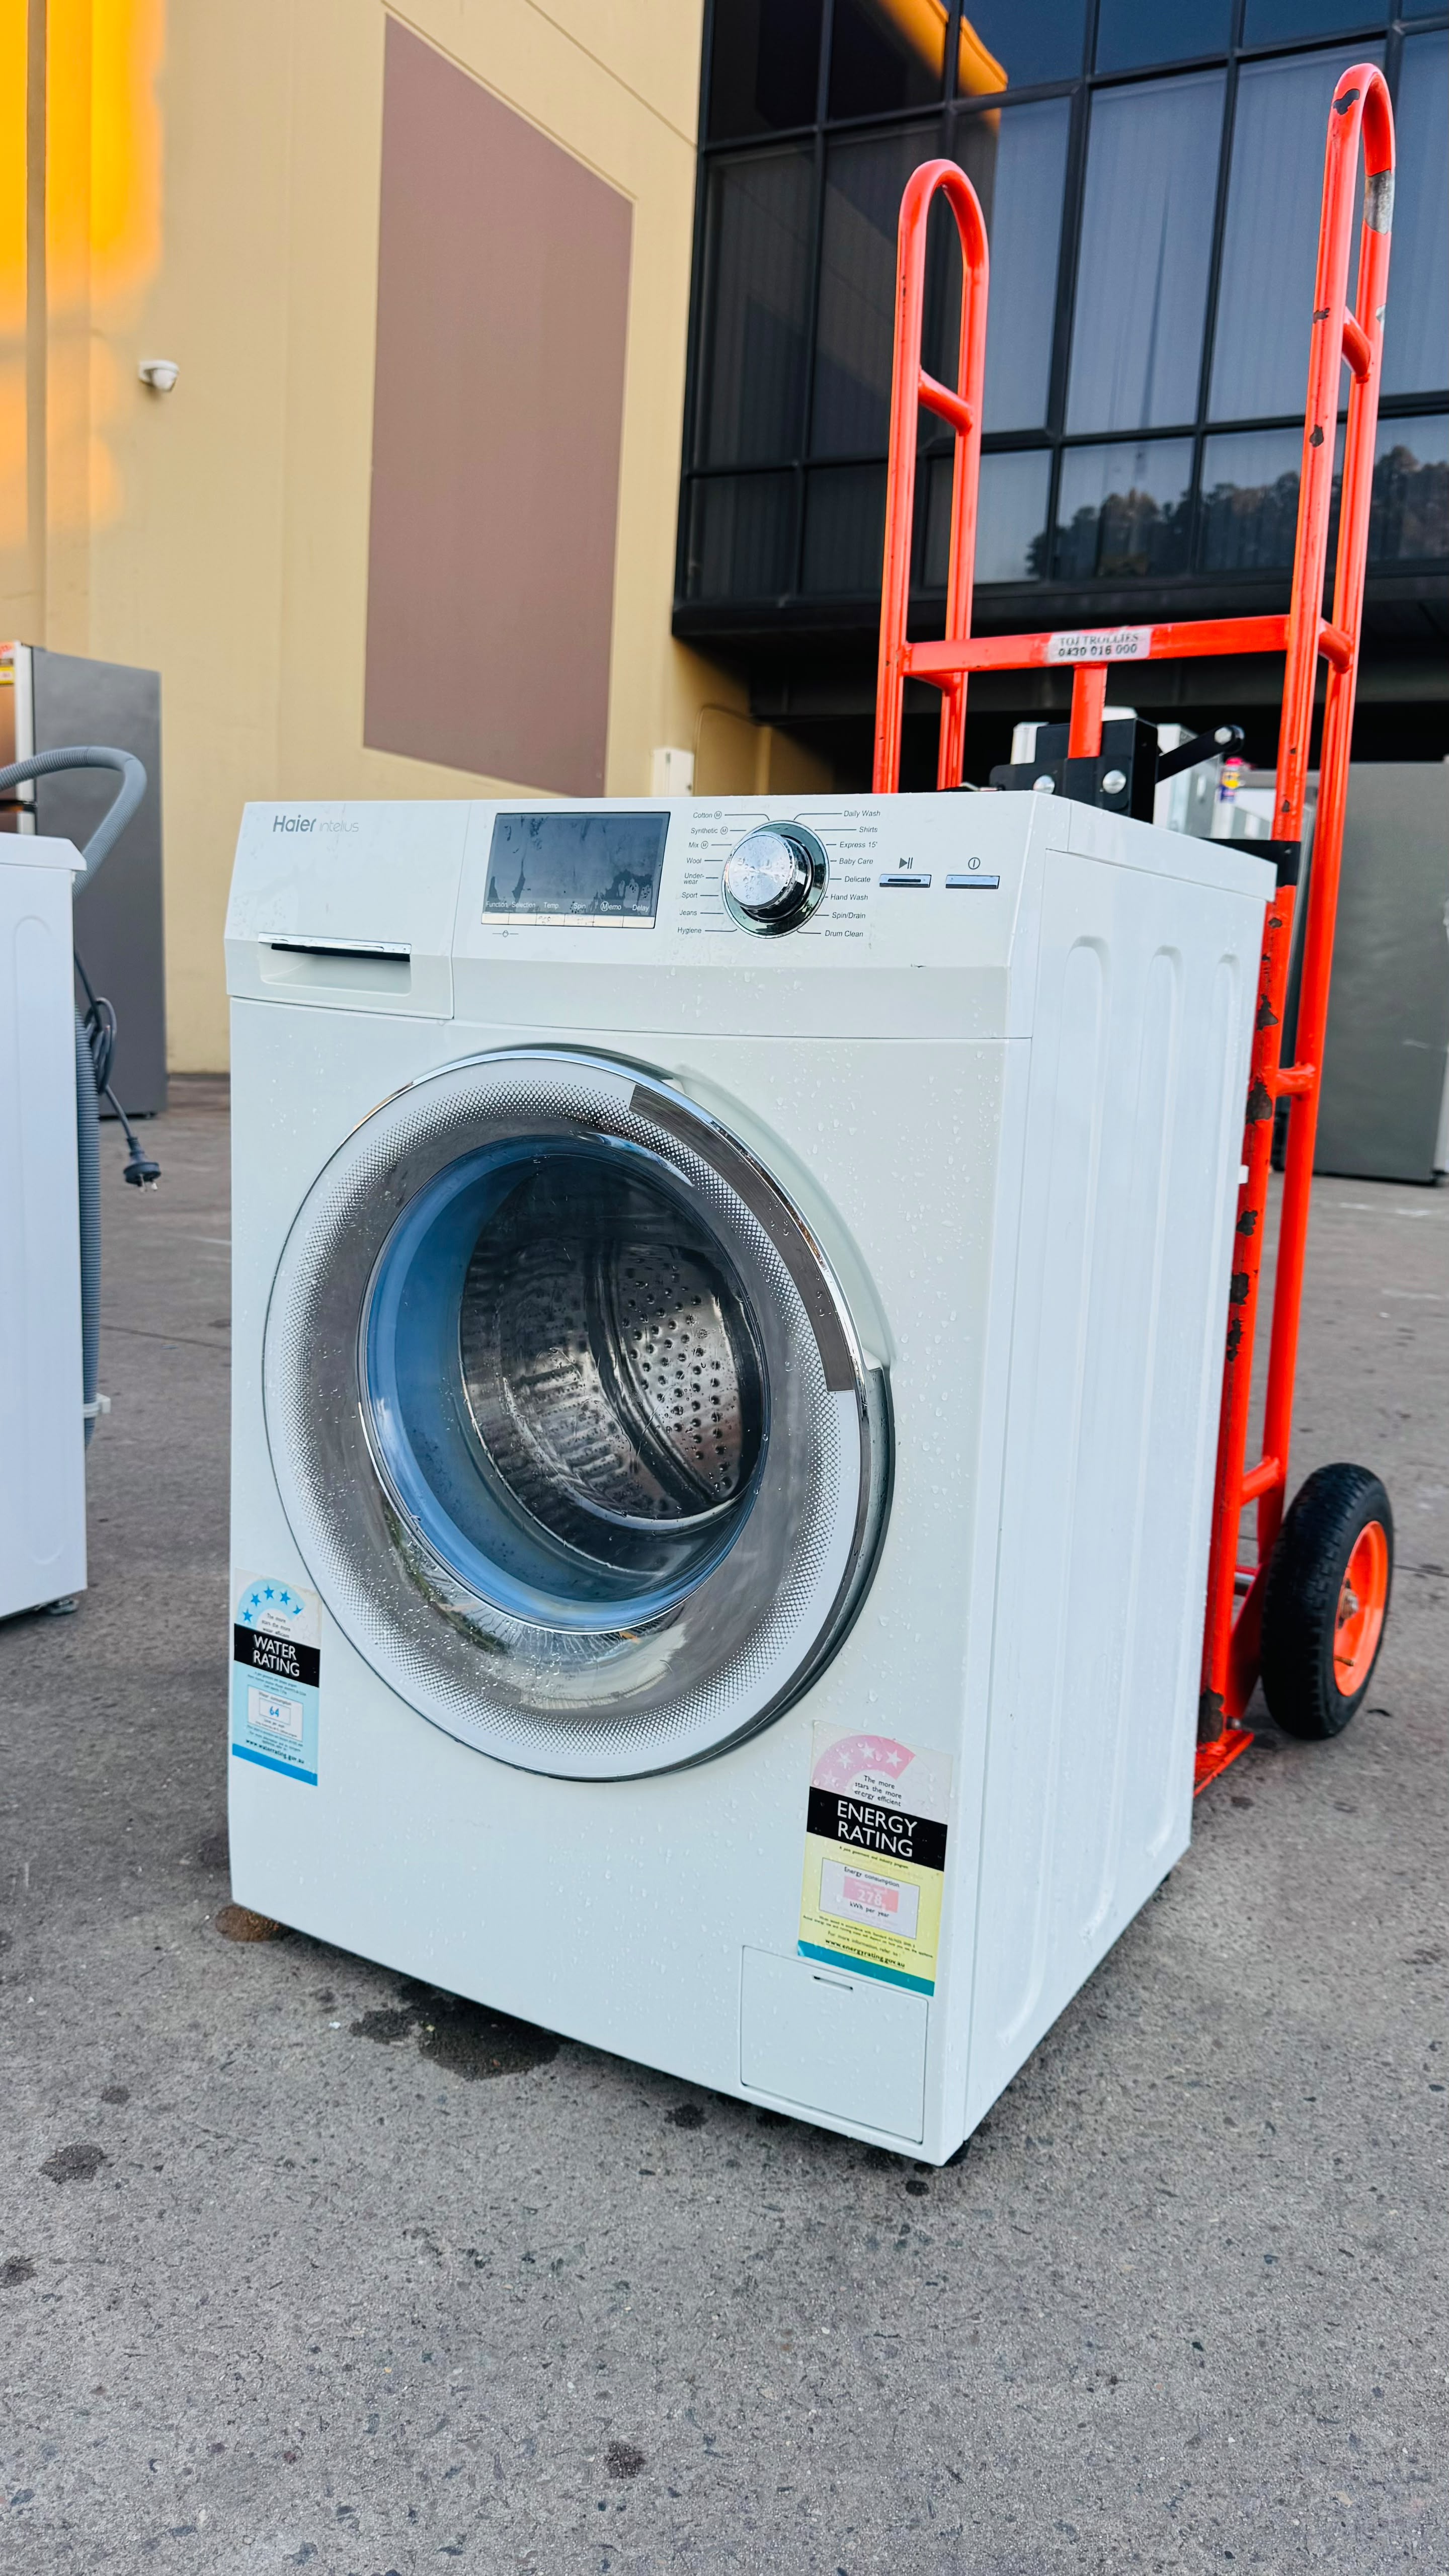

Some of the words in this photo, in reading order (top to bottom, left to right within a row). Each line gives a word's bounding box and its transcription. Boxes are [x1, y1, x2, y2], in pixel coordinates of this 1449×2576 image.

[1116, 643, 1137, 654] 000
[273, 815, 316, 832] Haier
[690, 827, 718, 835] Synthetic
[839, 841, 866, 849] Express
[839, 858, 856, 866] Baby
[681, 892, 698, 900] Sport
[600, 901, 622, 912] Memo
[632, 904, 650, 913] Delay
[832, 912, 866, 920] Spin/Drain
[254, 1634, 297, 1661] WATER
[253, 1650, 300, 1678] RATING
[269, 1706, 280, 1718] 64
[864, 1775, 875, 1784] The
[878, 1781, 895, 1789] more
[886, 1791, 902, 1799] more
[877, 1796, 902, 1807] efficient
[837, 1800, 918, 1837] ENERGY
[838, 1820, 913, 1858] RATING
[844, 1867, 862, 1878] Energy
[865, 1874, 900, 1888] consumption
[850, 1901, 863, 1910] kWh
